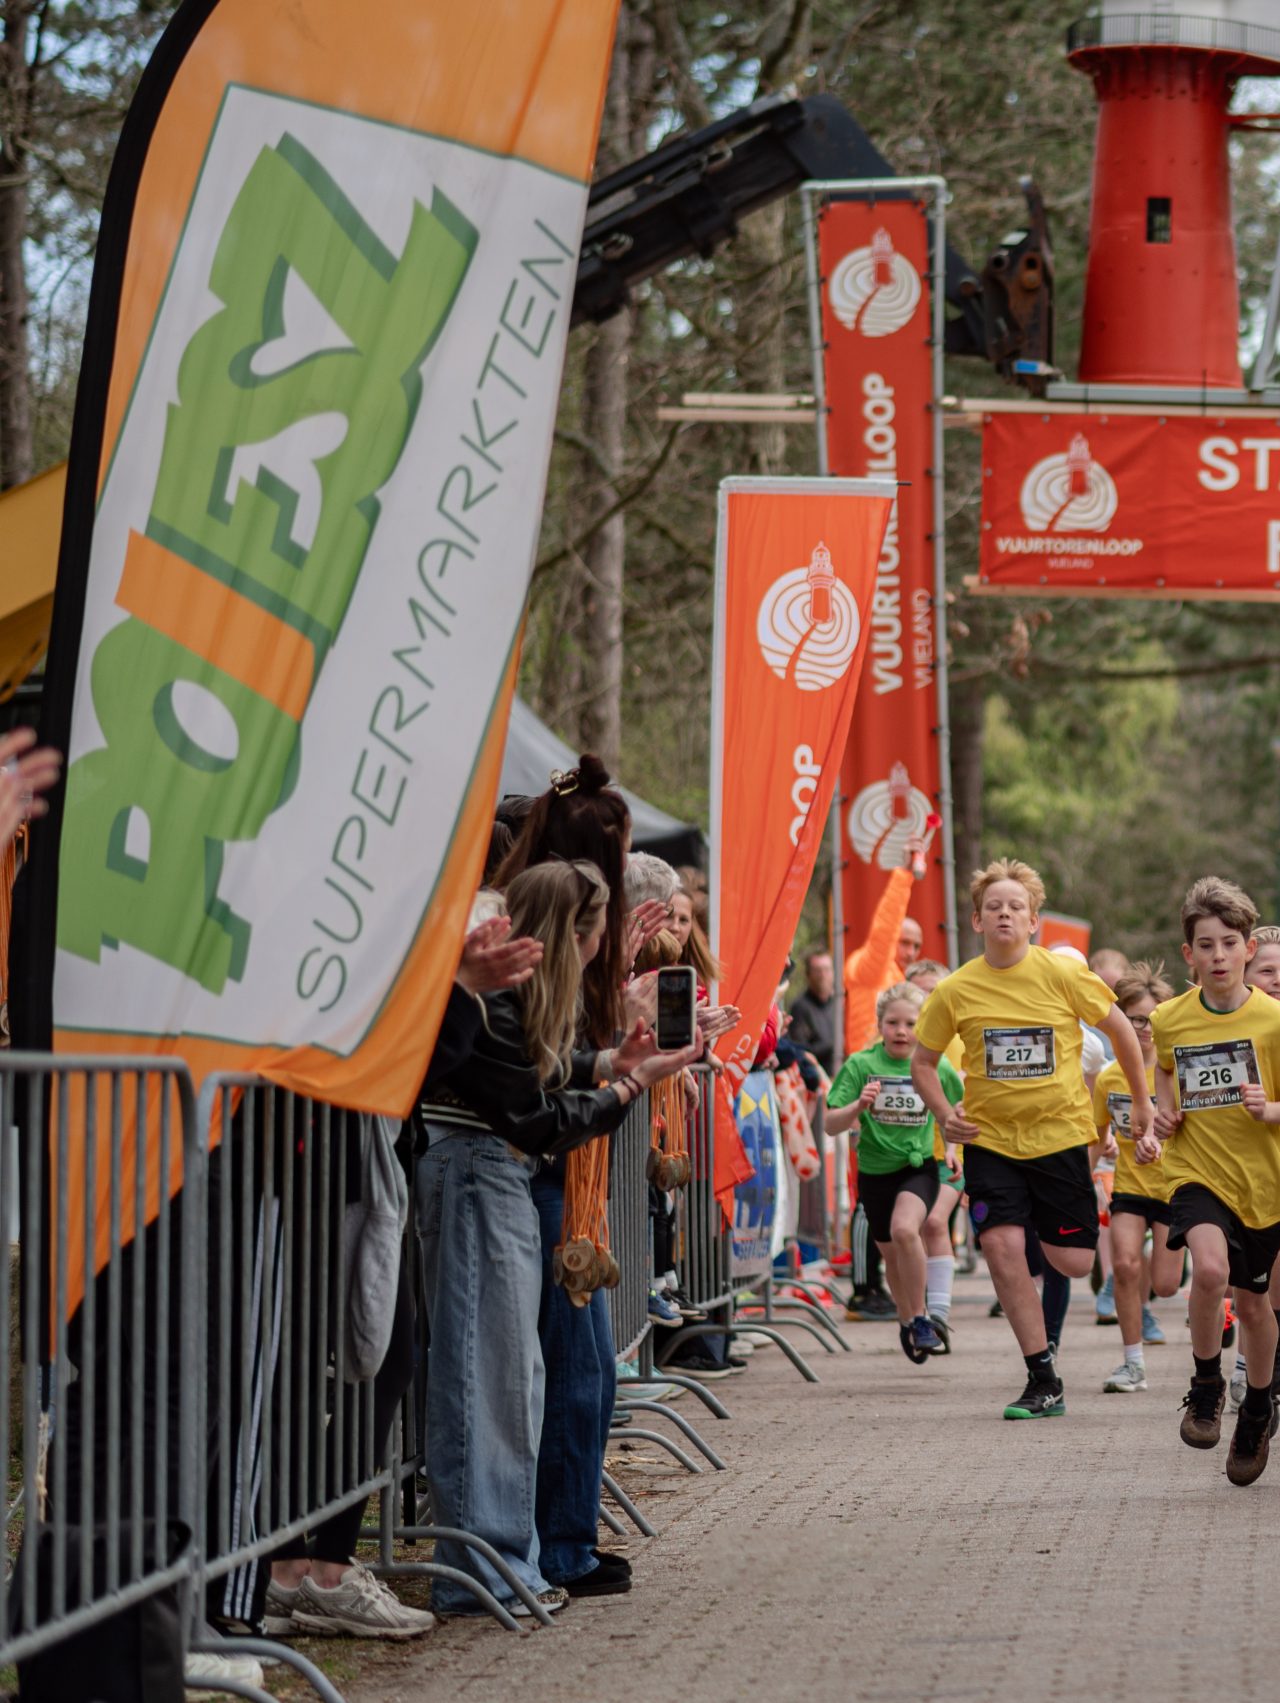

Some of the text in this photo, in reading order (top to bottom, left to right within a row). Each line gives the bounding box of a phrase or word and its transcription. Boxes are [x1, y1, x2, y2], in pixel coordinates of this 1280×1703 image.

[861, 373, 904, 695] VUURTOLOOP
[996, 537, 1143, 555] VUURTORENLOOP
[56, 131, 480, 997] POIESZ
[297, 218, 575, 1013] SUPERMARKTEN
[1006, 1048, 1032, 1062] 217
[1020, 1067, 1053, 1076] Vlieland
[1198, 1067, 1232, 1087] 216
[884, 1096, 915, 1109] 239
[1182, 1091, 1243, 1106] Jan van Vliel
